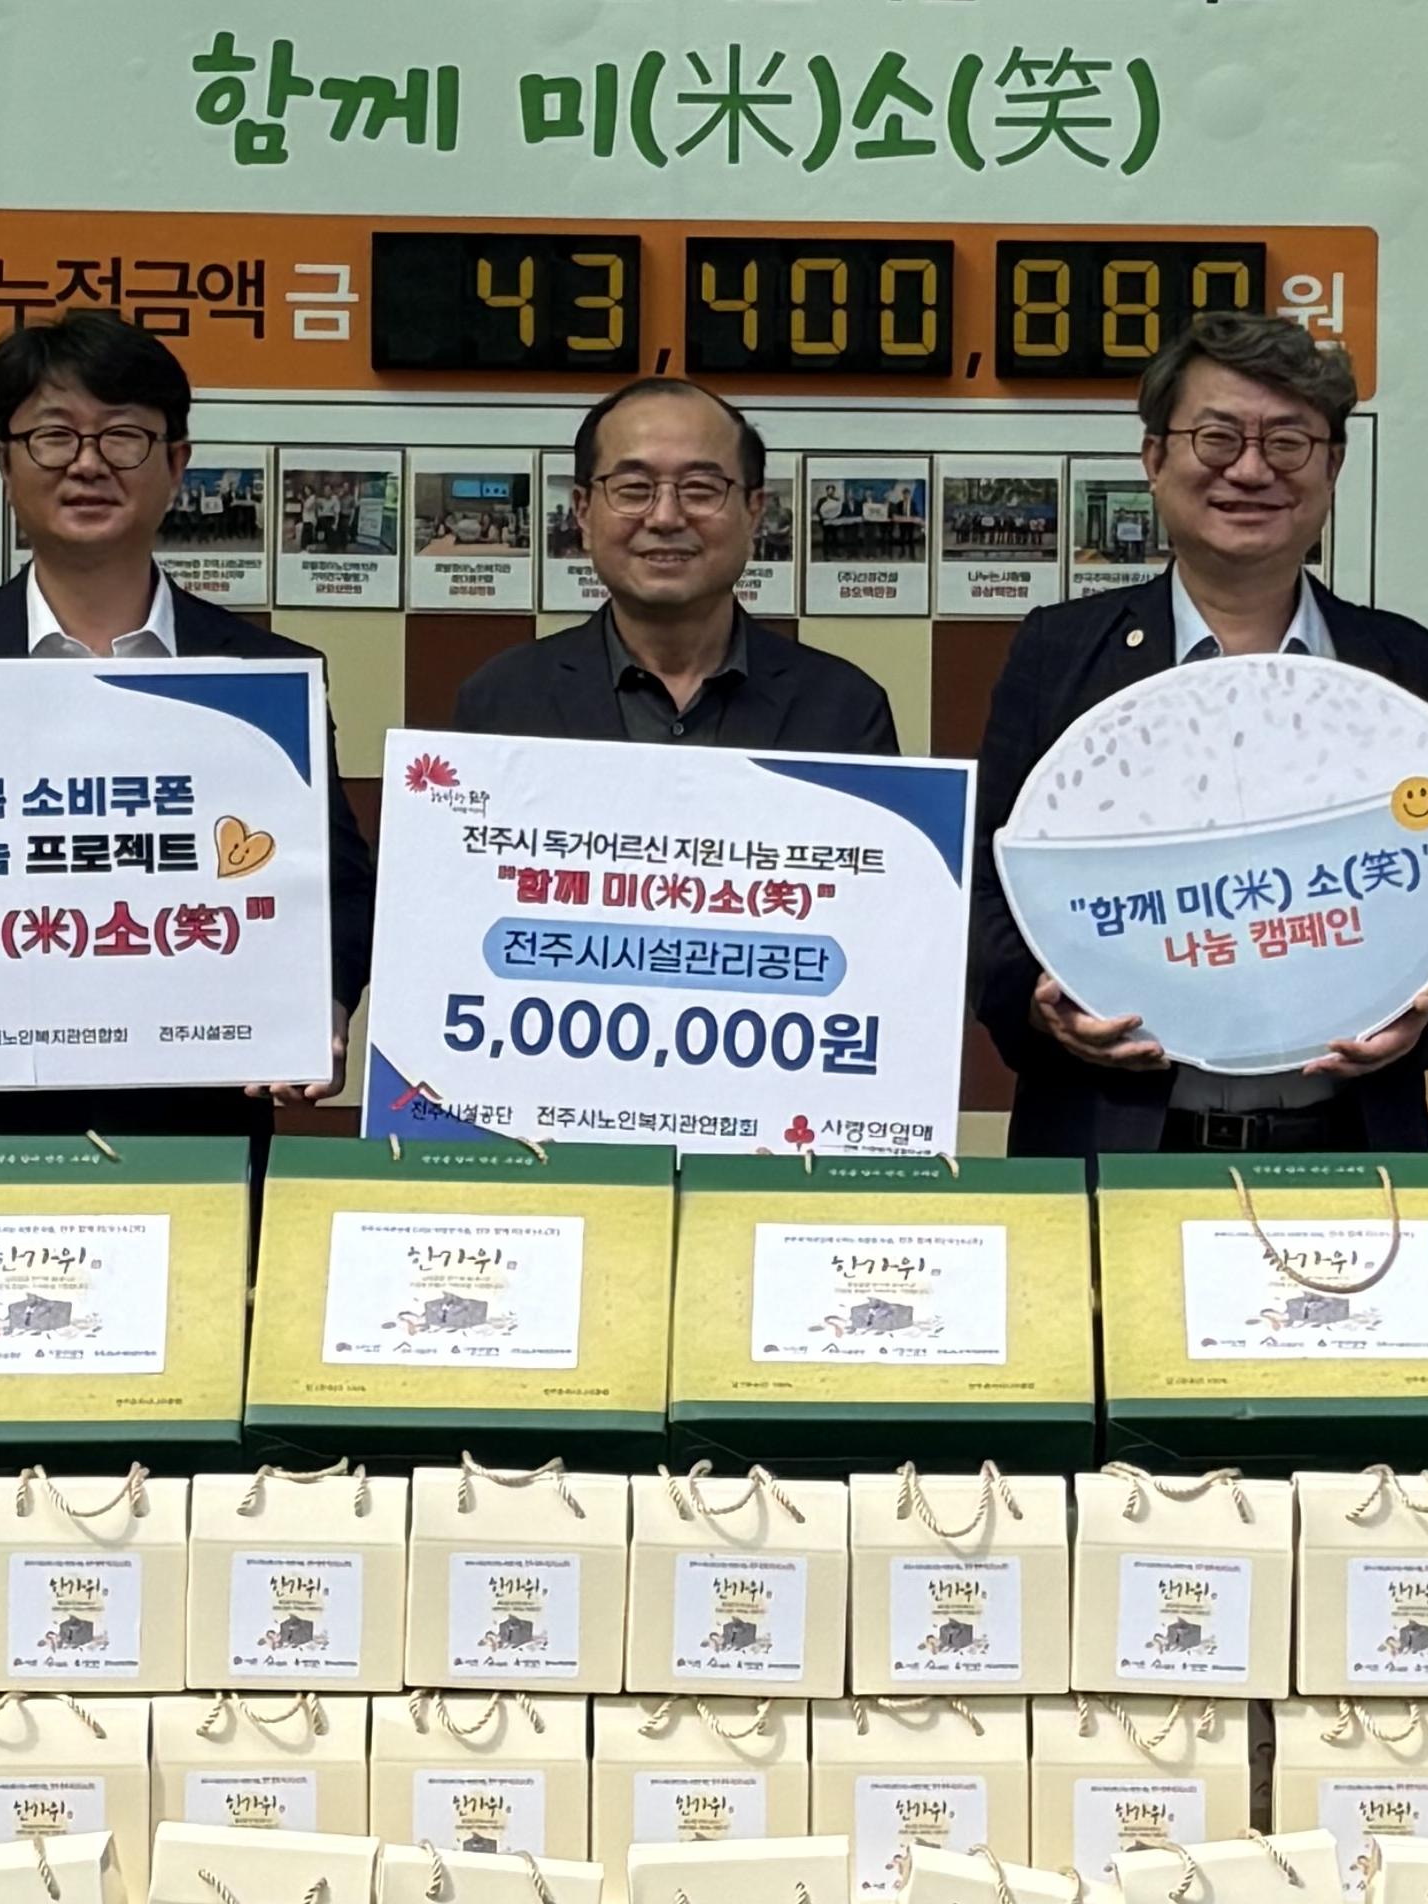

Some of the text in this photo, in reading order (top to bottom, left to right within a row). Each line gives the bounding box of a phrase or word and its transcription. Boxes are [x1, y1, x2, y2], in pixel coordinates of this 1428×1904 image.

[192, 31, 459, 167] 함께
[284, 262, 360, 341] 금
[22, 775, 196, 818] 소비쿠폰
[26, 832, 199, 875] 프로젝트
[462, 825, 886, 874] 전주시 독거어르신 지원 나눔 프로젝트
[503, 930, 829, 982] 전주시시설관리공단
[1164, 907, 1364, 968] 나눔 캠페인
[158, 1022, 253, 1042] 전주시설공단
[444, 994, 880, 1075] 5,000,000원
[410, 1101, 934, 1144] 전주시설공단 전주시노인복지관연합회 사랑의열매
[407, 1246, 502, 1274] 한가위
[831, 1255, 925, 1281] 한가위
